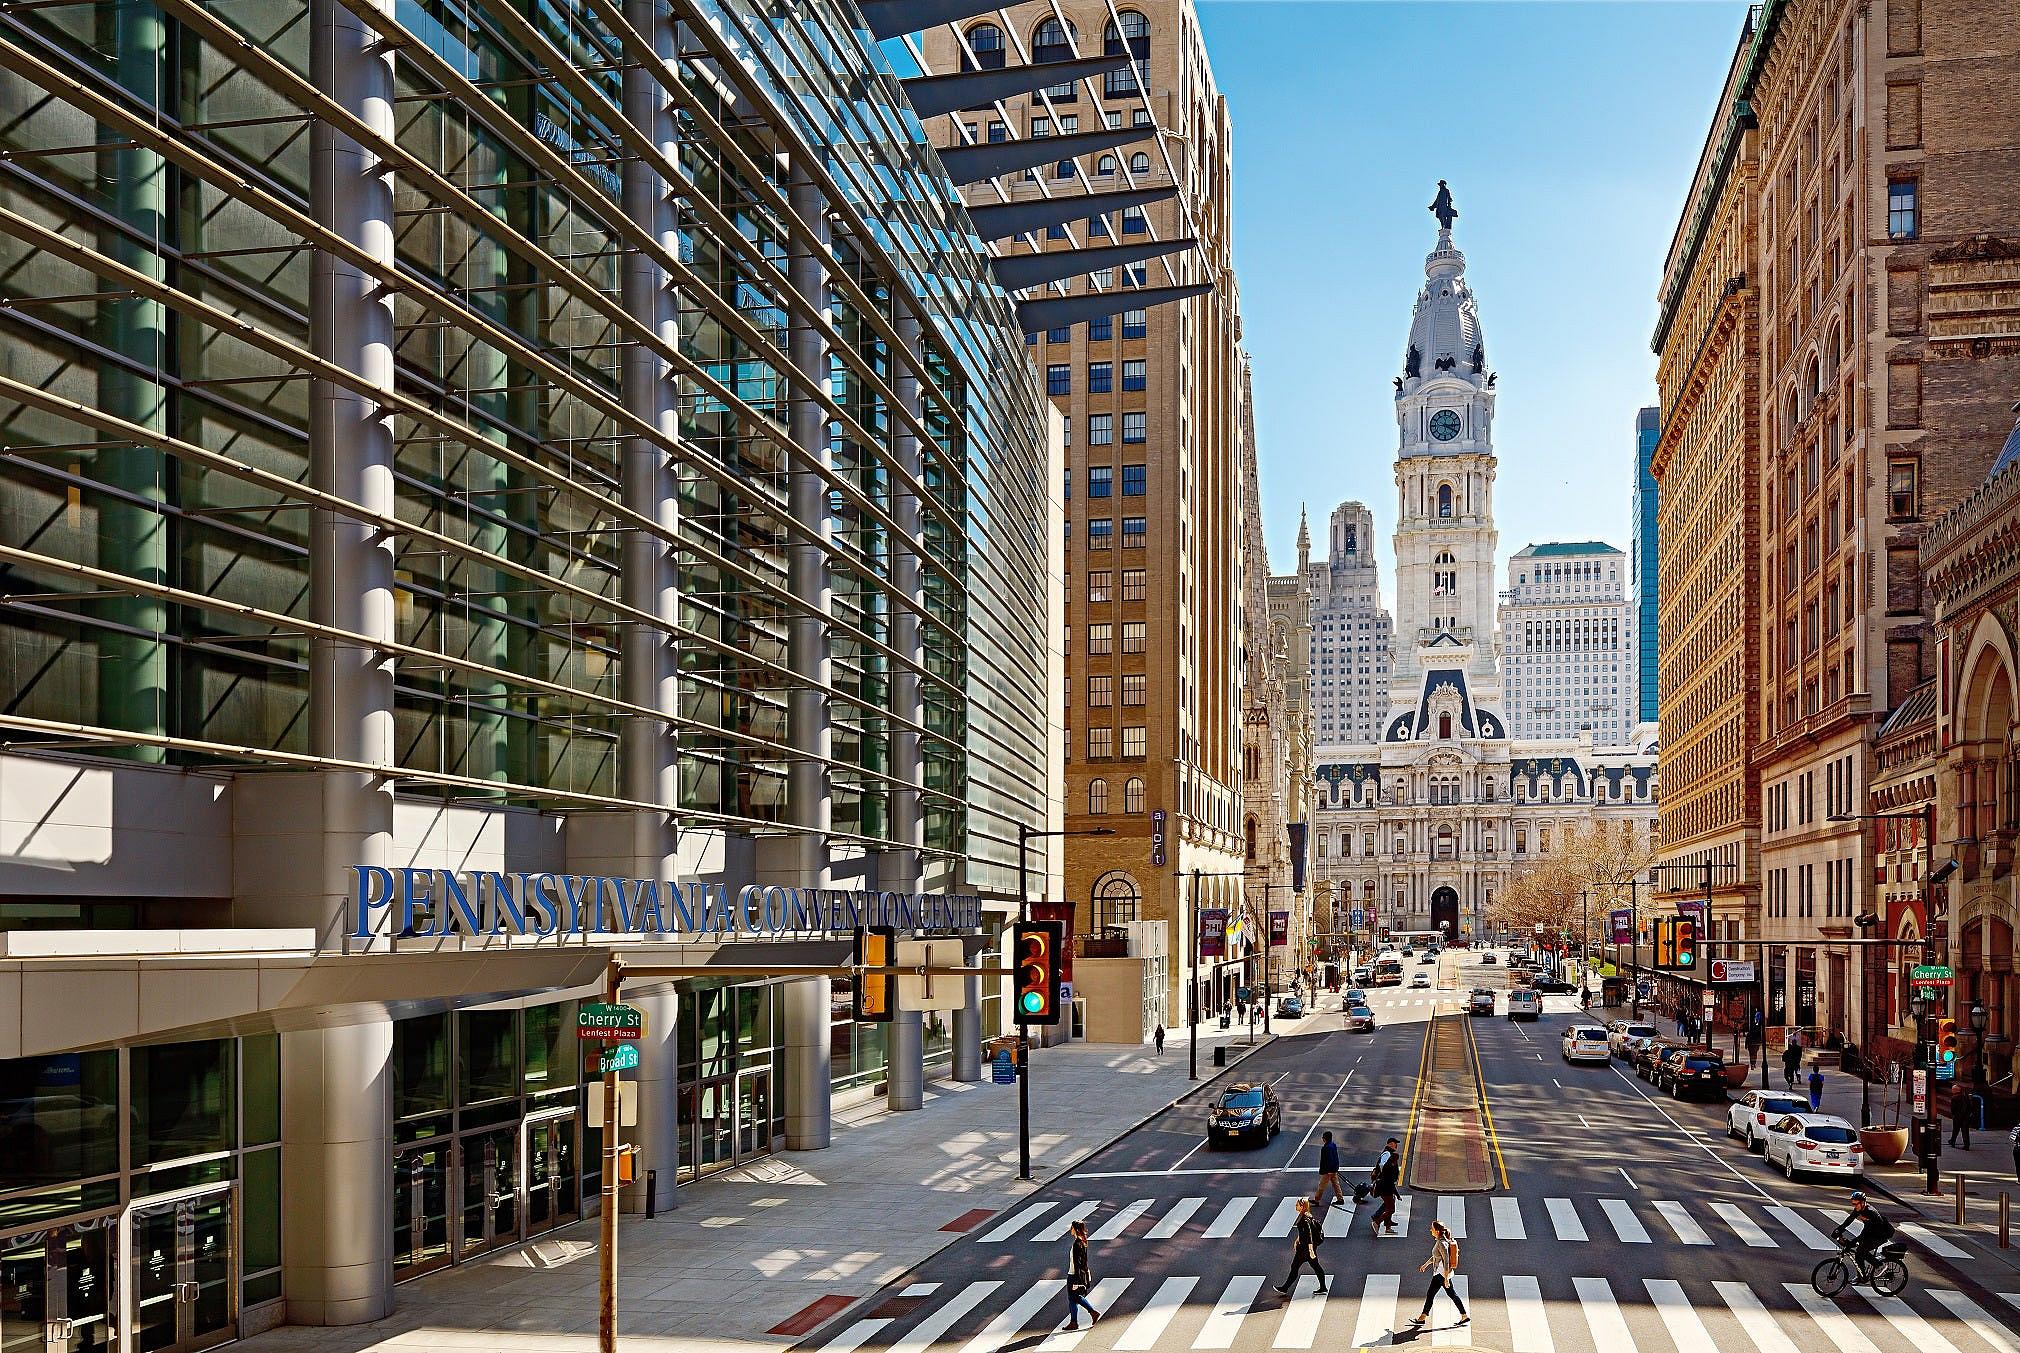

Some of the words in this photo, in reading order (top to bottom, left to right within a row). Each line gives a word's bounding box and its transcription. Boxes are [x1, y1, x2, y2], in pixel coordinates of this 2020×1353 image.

[350, 865, 733, 938] PENNSYLVANIA
[739, 884, 914, 933] CONVENTION
[917, 891, 983, 931] CENTER
[1914, 970, 1942, 980] Cherry
[1944, 970, 1952, 978] St
[579, 1012, 622, 1028] Cherry
[627, 1014, 639, 1026] St
[581, 1029, 611, 1037] Lenfest
[613, 1029, 636, 1037] Plaza
[600, 1053, 626, 1071] Broad
[628, 1053, 638, 1066] St
